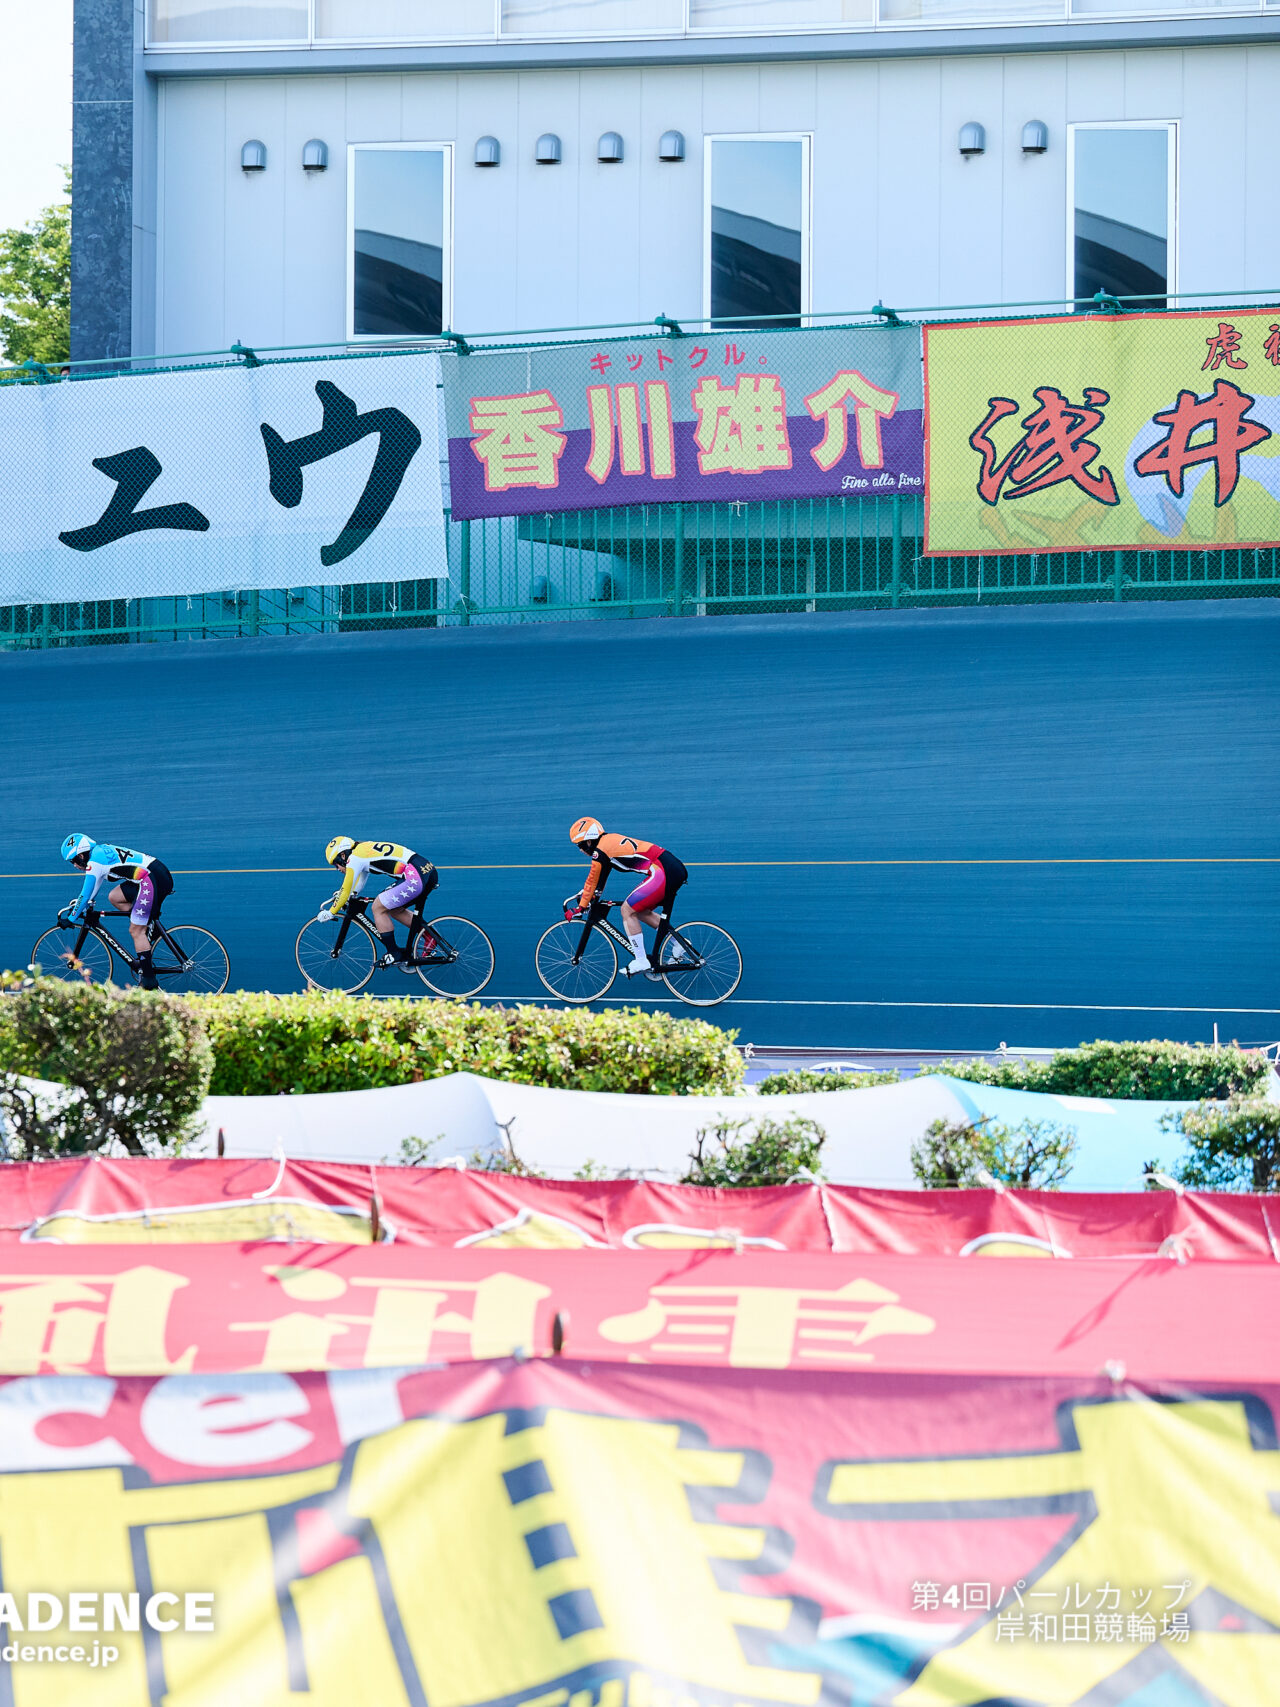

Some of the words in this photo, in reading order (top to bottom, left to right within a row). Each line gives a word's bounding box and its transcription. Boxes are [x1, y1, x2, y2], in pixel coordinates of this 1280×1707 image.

[469, 369, 900, 493] 香川雄介
[969, 379, 1273, 507] 浅井
[841, 475, 870, 489] Fino
[872, 472, 895, 486] alla
[898, 472, 922, 488] fine
[578, 820, 587, 832] 7
[66, 836, 76, 847] 4
[373, 843, 395, 857] 5
[620, 838, 638, 851] 7
[115, 847, 133, 864] 4
[95, 926, 133, 963] ANCHOR
